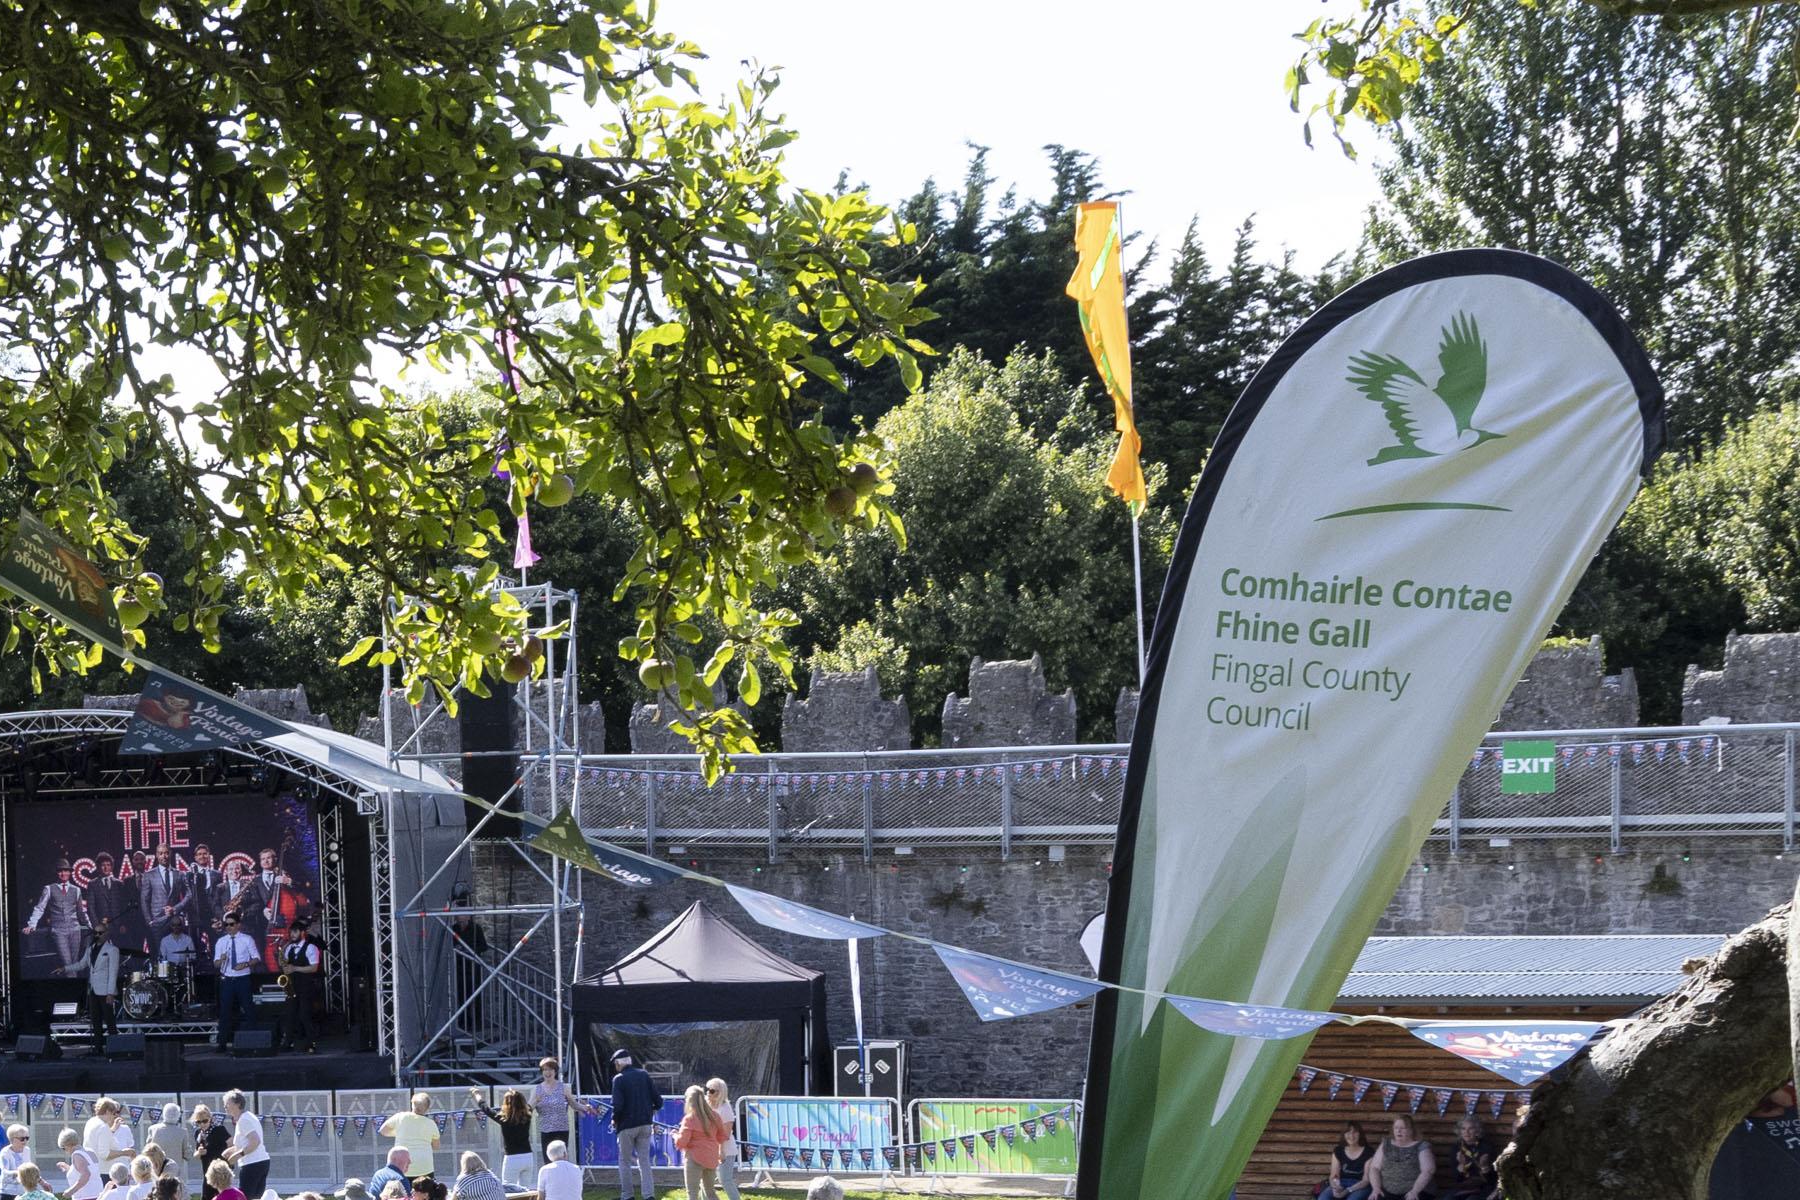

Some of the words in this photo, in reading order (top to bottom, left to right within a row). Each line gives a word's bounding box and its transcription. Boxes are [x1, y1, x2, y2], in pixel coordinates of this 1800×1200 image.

[12, 550, 75, 601] Vintage
[1221, 568, 1383, 606] Comhairle
[1393, 579, 1513, 613] Contae
[1215, 610, 1300, 645] Fhine
[1308, 618, 1372, 648] Gall
[1210, 653, 1294, 693] Fingal
[1302, 660, 1411, 702] County
[188, 715, 241, 744] Picnic
[193, 701, 263, 739] Vintage
[1206, 697, 1312, 731] Council
[1502, 757, 1555, 774] EXIT
[116, 808, 190, 850] THE
[997, 968, 1081, 998] Vintage
[1237, 1009, 1330, 1021] Vintage
[1486, 1031, 1586, 1043] Vintage
